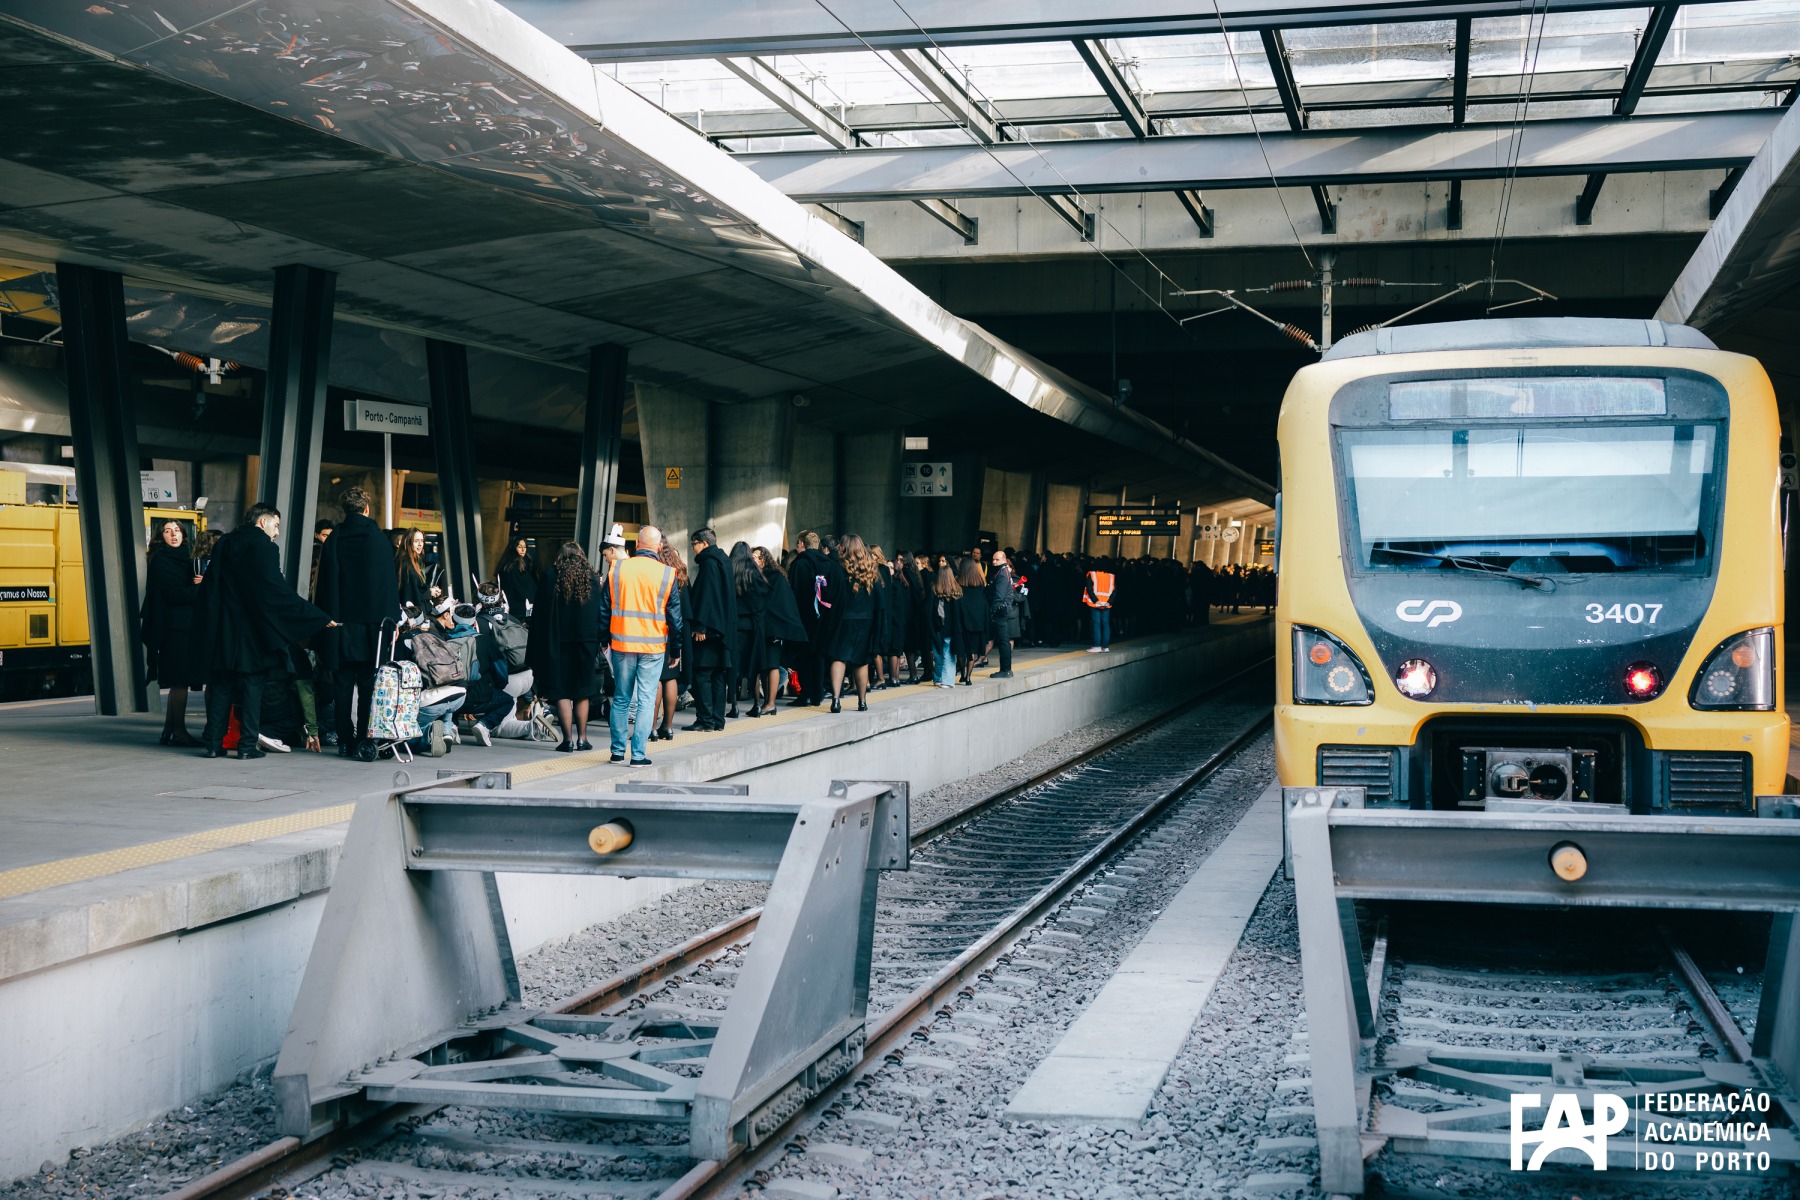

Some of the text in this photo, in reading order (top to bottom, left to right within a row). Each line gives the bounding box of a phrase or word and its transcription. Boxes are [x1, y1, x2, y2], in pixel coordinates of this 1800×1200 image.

[1323, 303, 1330, 316] 2
[365, 410, 384, 422] Porto
[389, 412, 422, 427] Campanhã
[907, 484, 914, 492] A
[149, 491, 159, 499] 16
[1585, 603, 1663, 624] 3407
